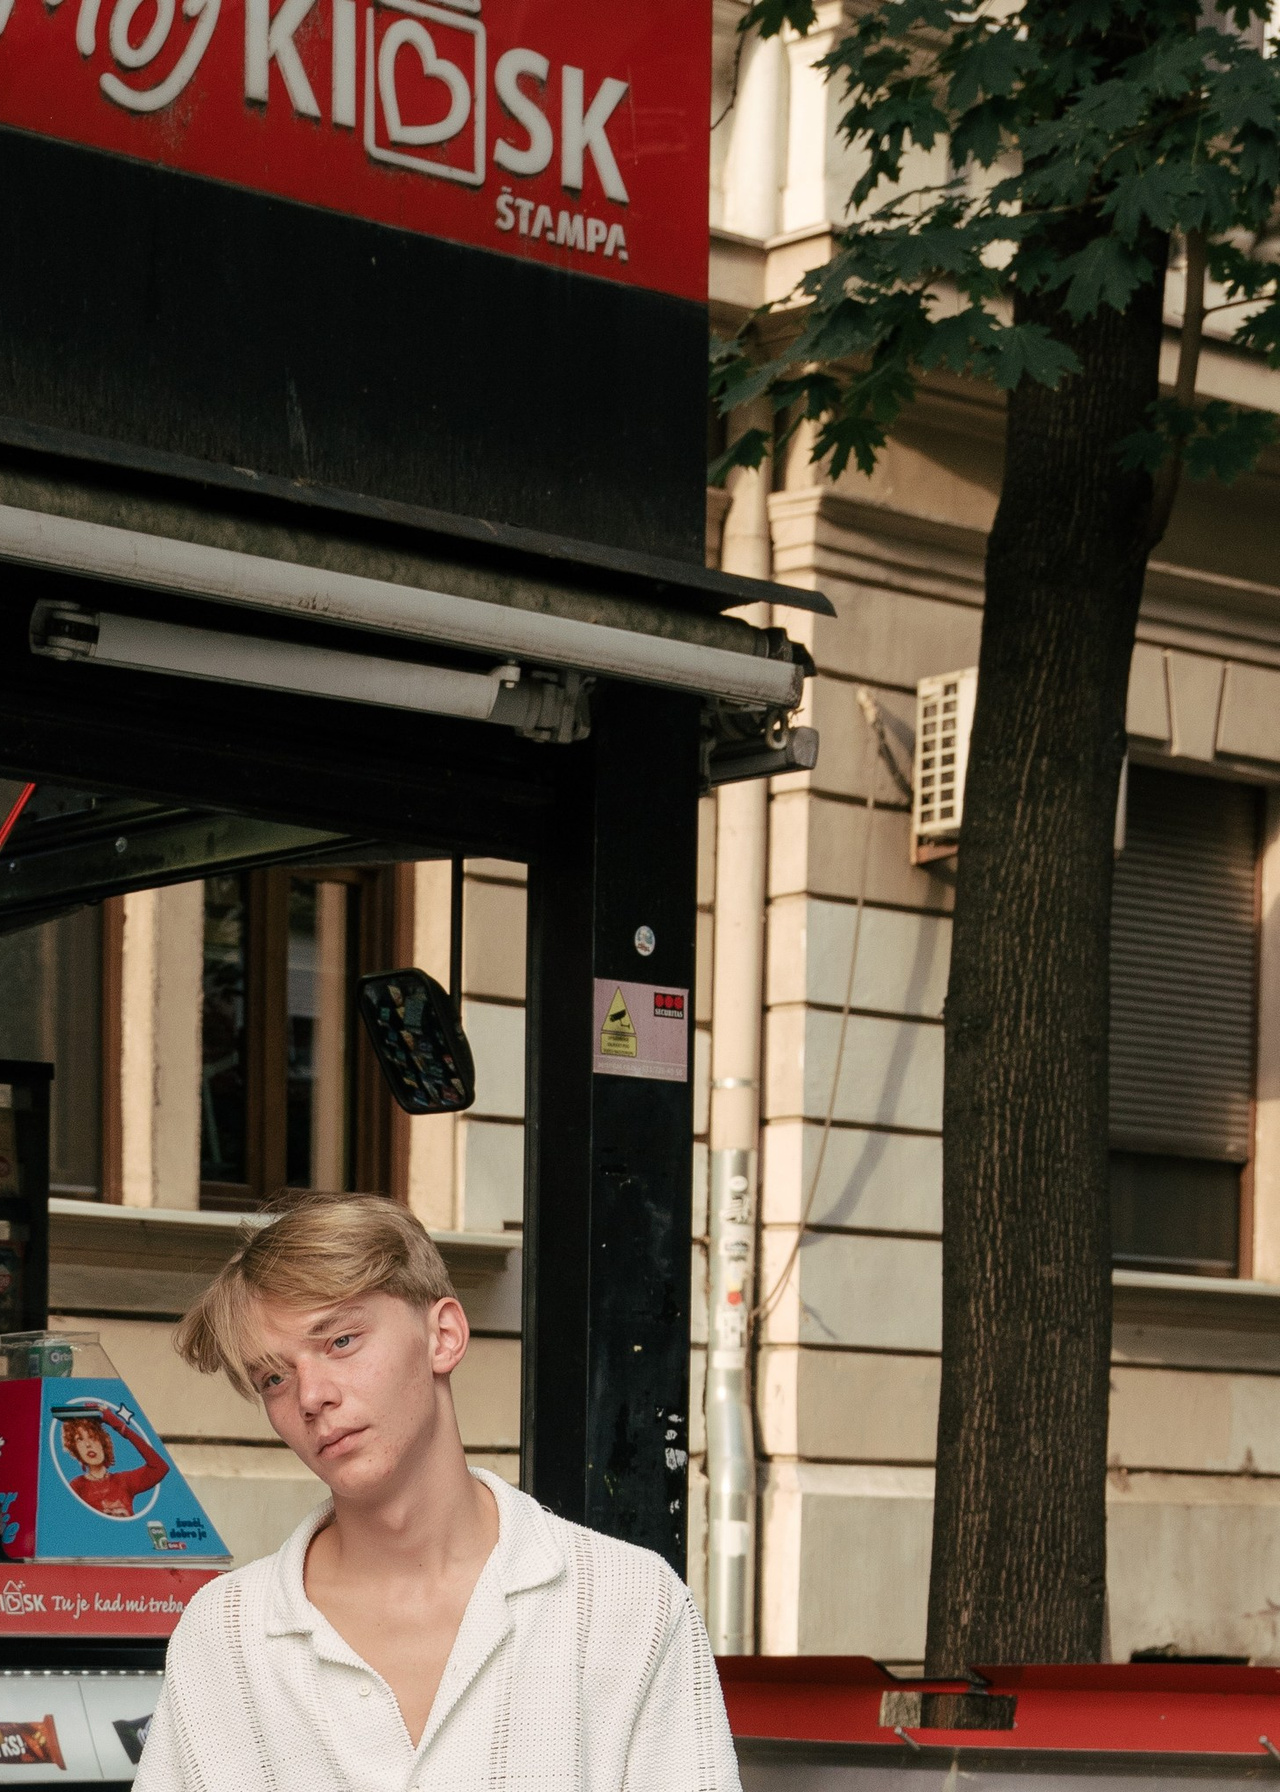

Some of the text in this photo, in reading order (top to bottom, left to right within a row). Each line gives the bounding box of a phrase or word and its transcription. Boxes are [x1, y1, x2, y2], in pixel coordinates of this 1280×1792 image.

[493, 186, 630, 262] ŠTAMPA
[655, 1007, 683, 1018] SECURITAS
[51, 1595, 75, 1611] Tu
[73, 1593, 91, 1619] je
[94, 1592, 124, 1612] kad
[125, 1595, 149, 1612] mi
